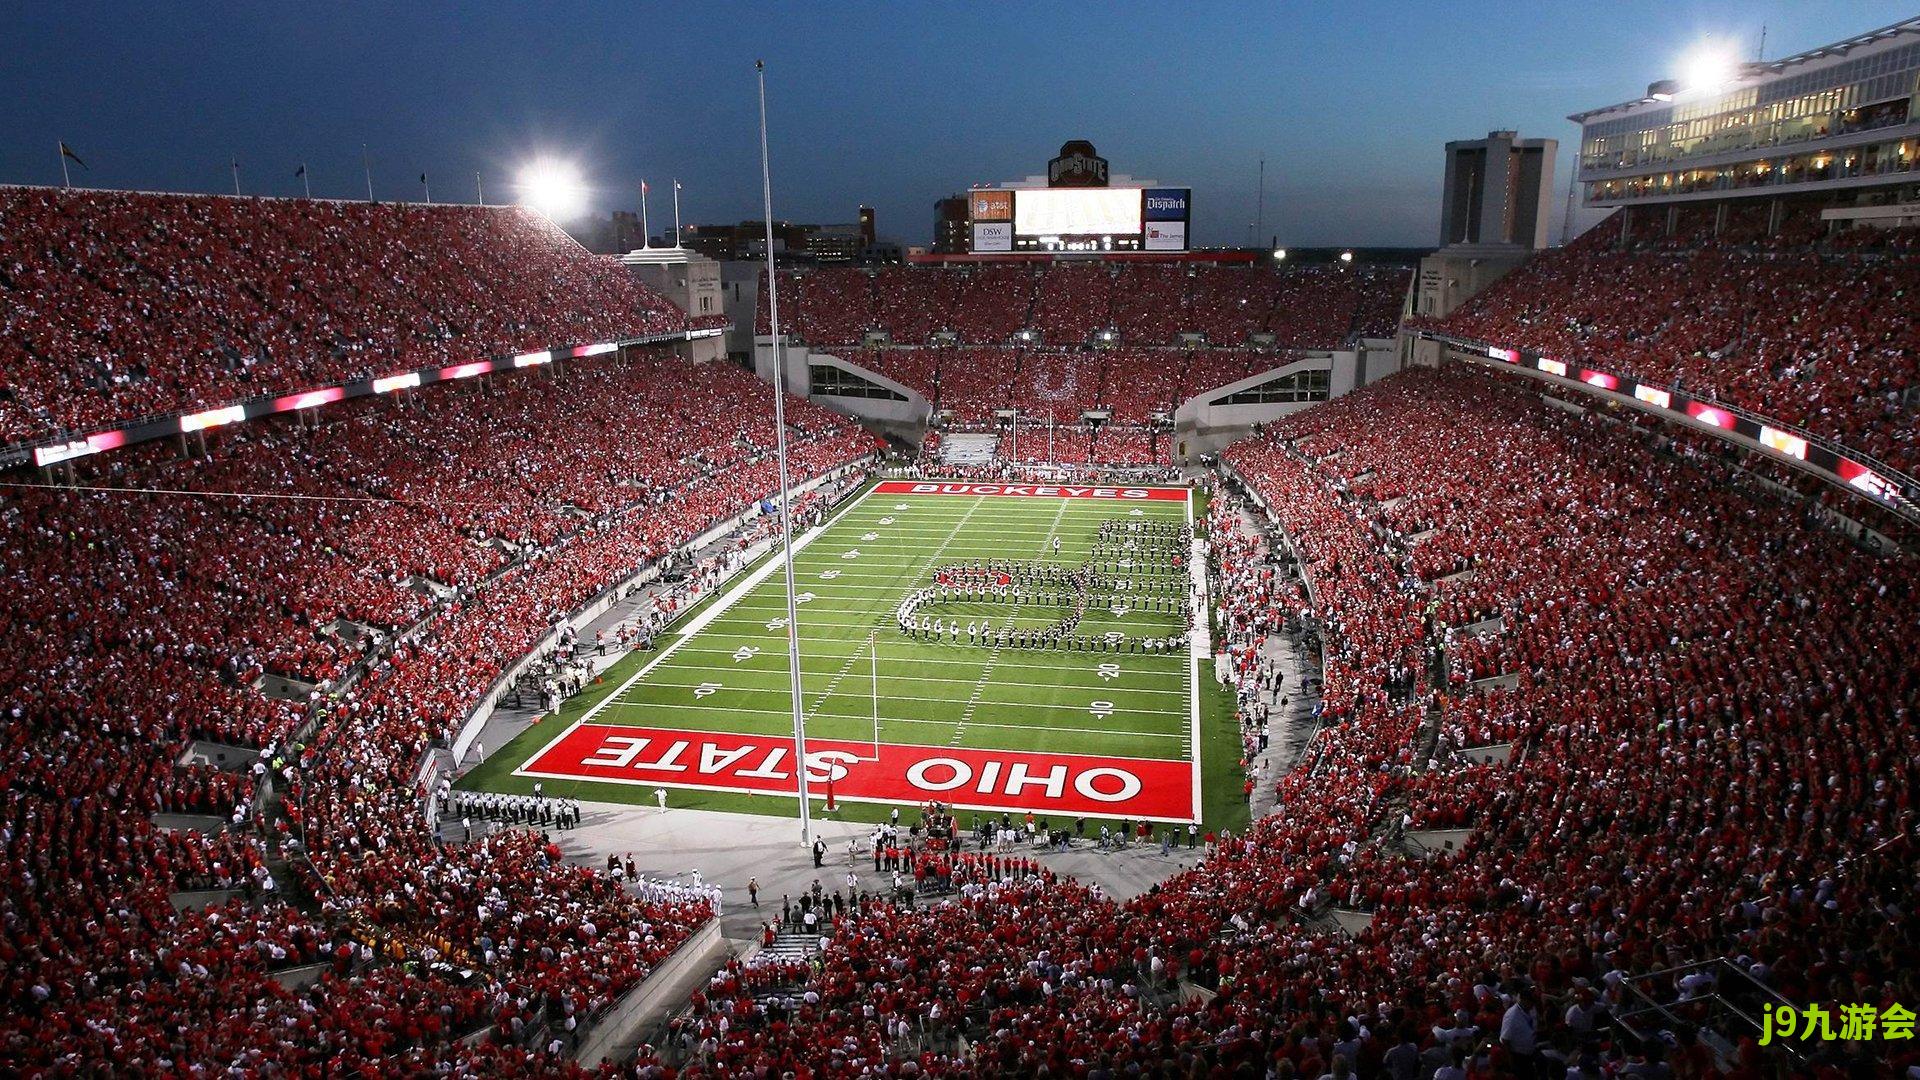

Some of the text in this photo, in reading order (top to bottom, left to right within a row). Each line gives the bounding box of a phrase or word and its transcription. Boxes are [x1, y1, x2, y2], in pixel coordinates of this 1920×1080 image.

[1147, 197, 1185, 210] Dispatch
[983, 228, 1003, 236] DSW
[911, 484, 1149, 498] BUCKEYES
[1098, 663, 1120, 678] 20
[1089, 701, 1114, 715] 10
[580, 736, 1142, 802] OHIO STATE
